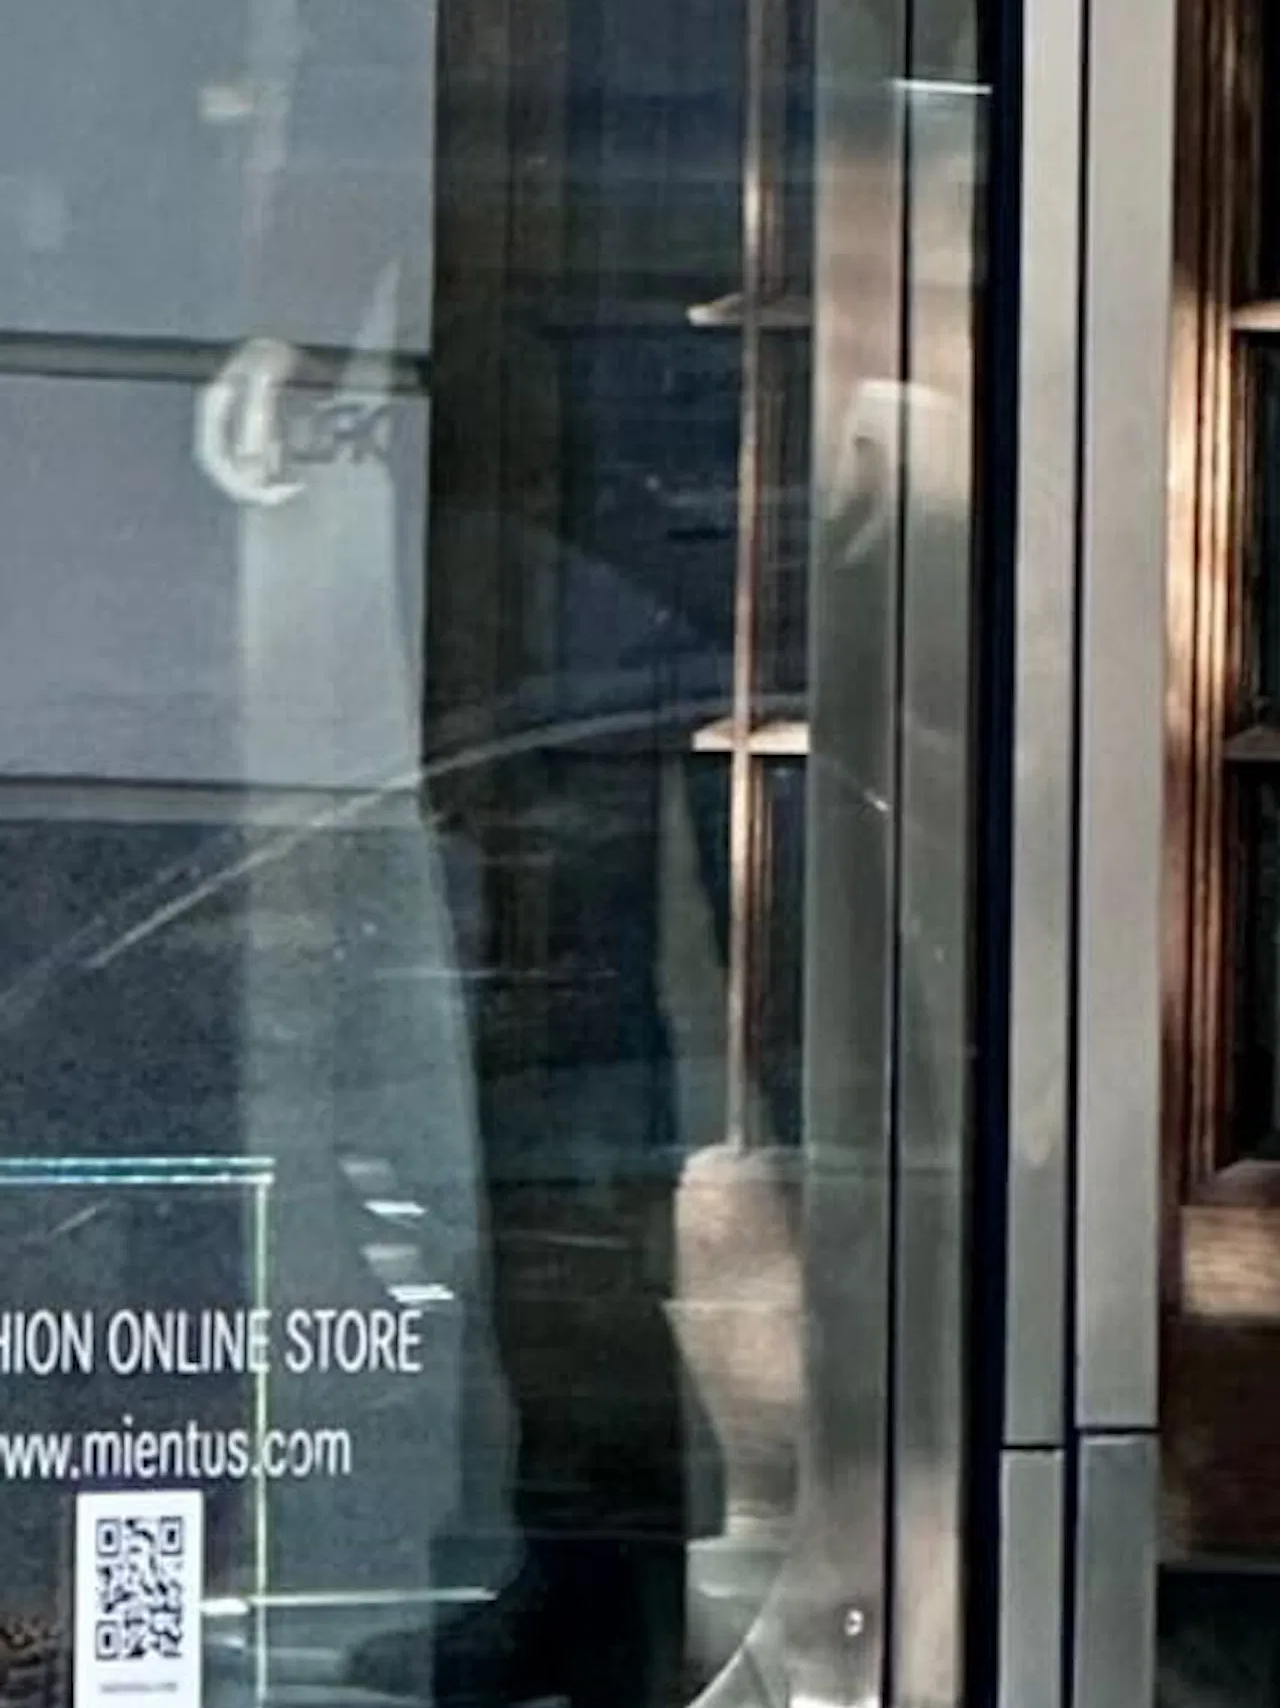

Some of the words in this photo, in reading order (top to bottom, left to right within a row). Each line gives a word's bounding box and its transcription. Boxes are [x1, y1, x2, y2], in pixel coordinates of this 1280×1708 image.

[107, 1309, 271, 1375] ONLINE
[285, 1309, 422, 1374] STORE
[0, 1415, 352, 1482] ww.mientus.com
